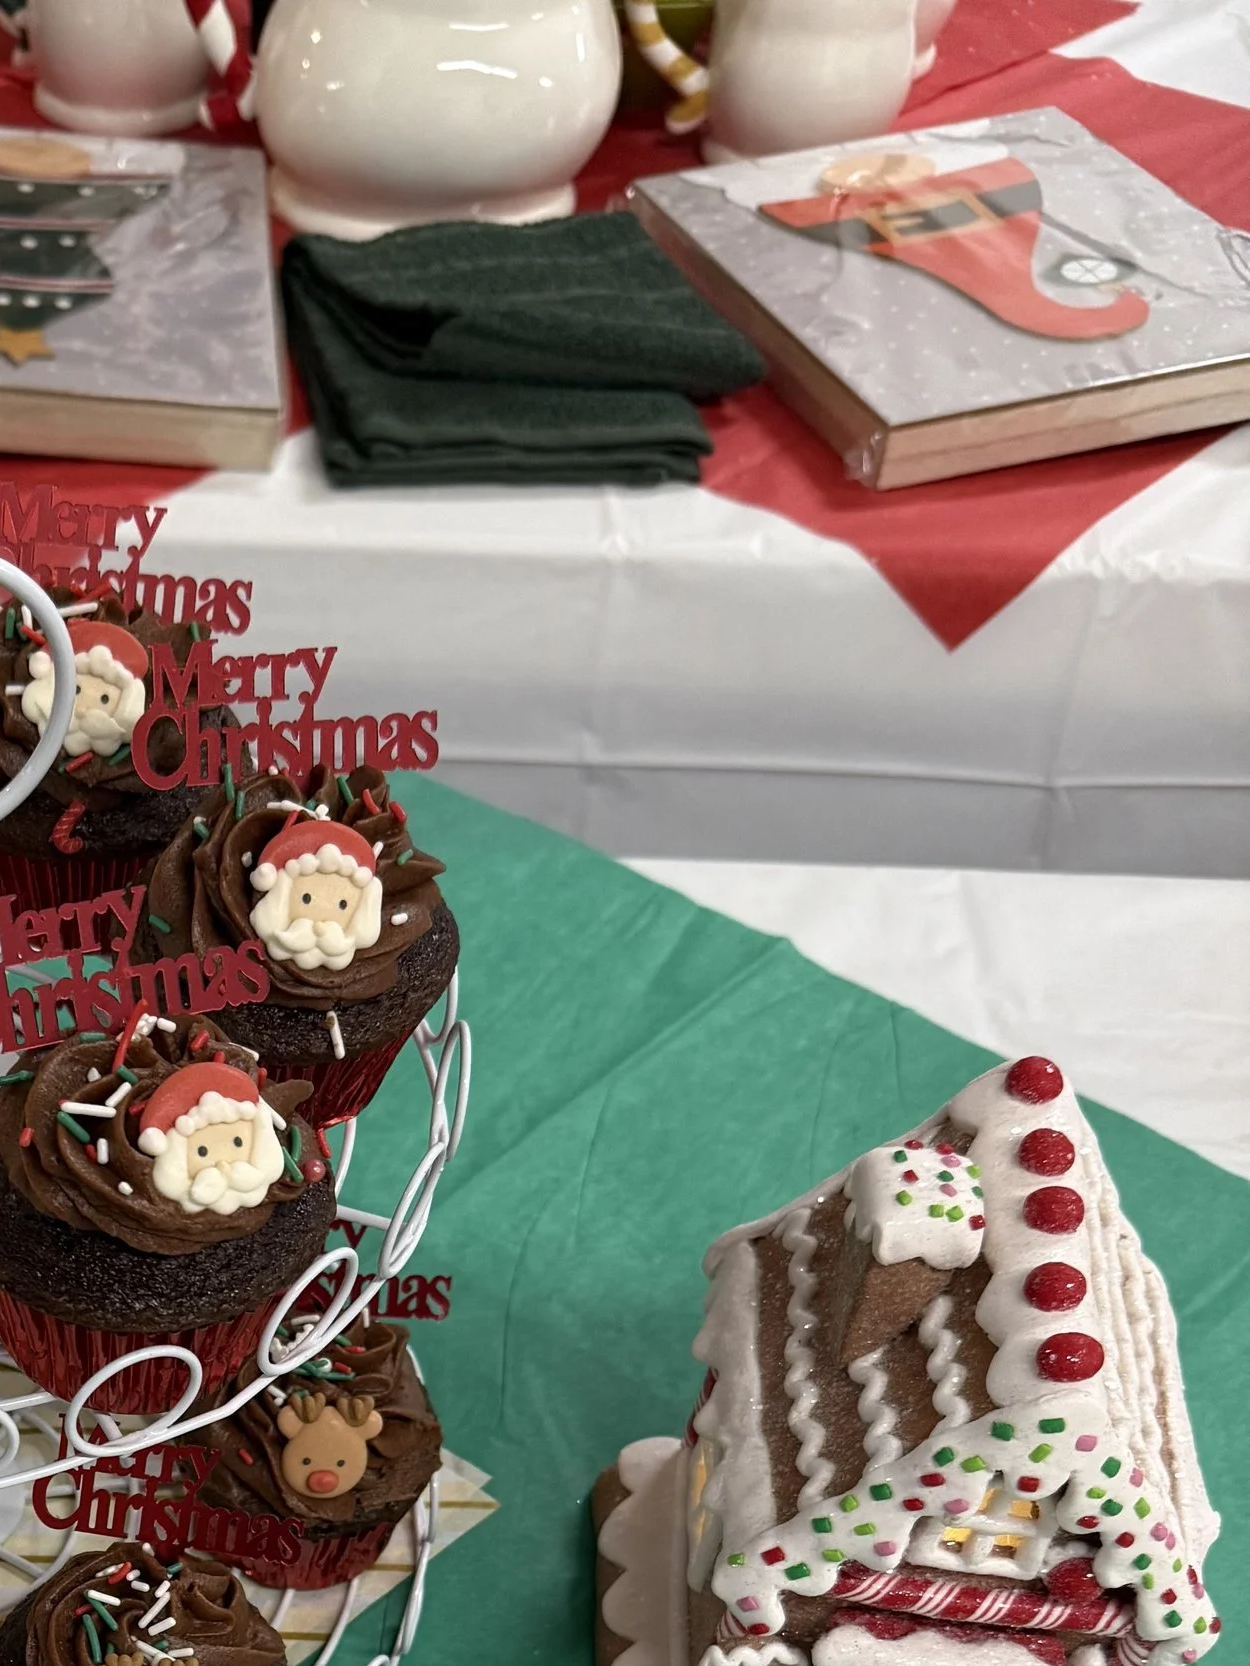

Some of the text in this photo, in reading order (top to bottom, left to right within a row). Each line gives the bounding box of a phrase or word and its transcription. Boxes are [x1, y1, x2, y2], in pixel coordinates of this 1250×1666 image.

[148, 639, 337, 715] Merry
[131, 706, 439, 790] Christmas
[32, 1471, 306, 1566] Christmas
